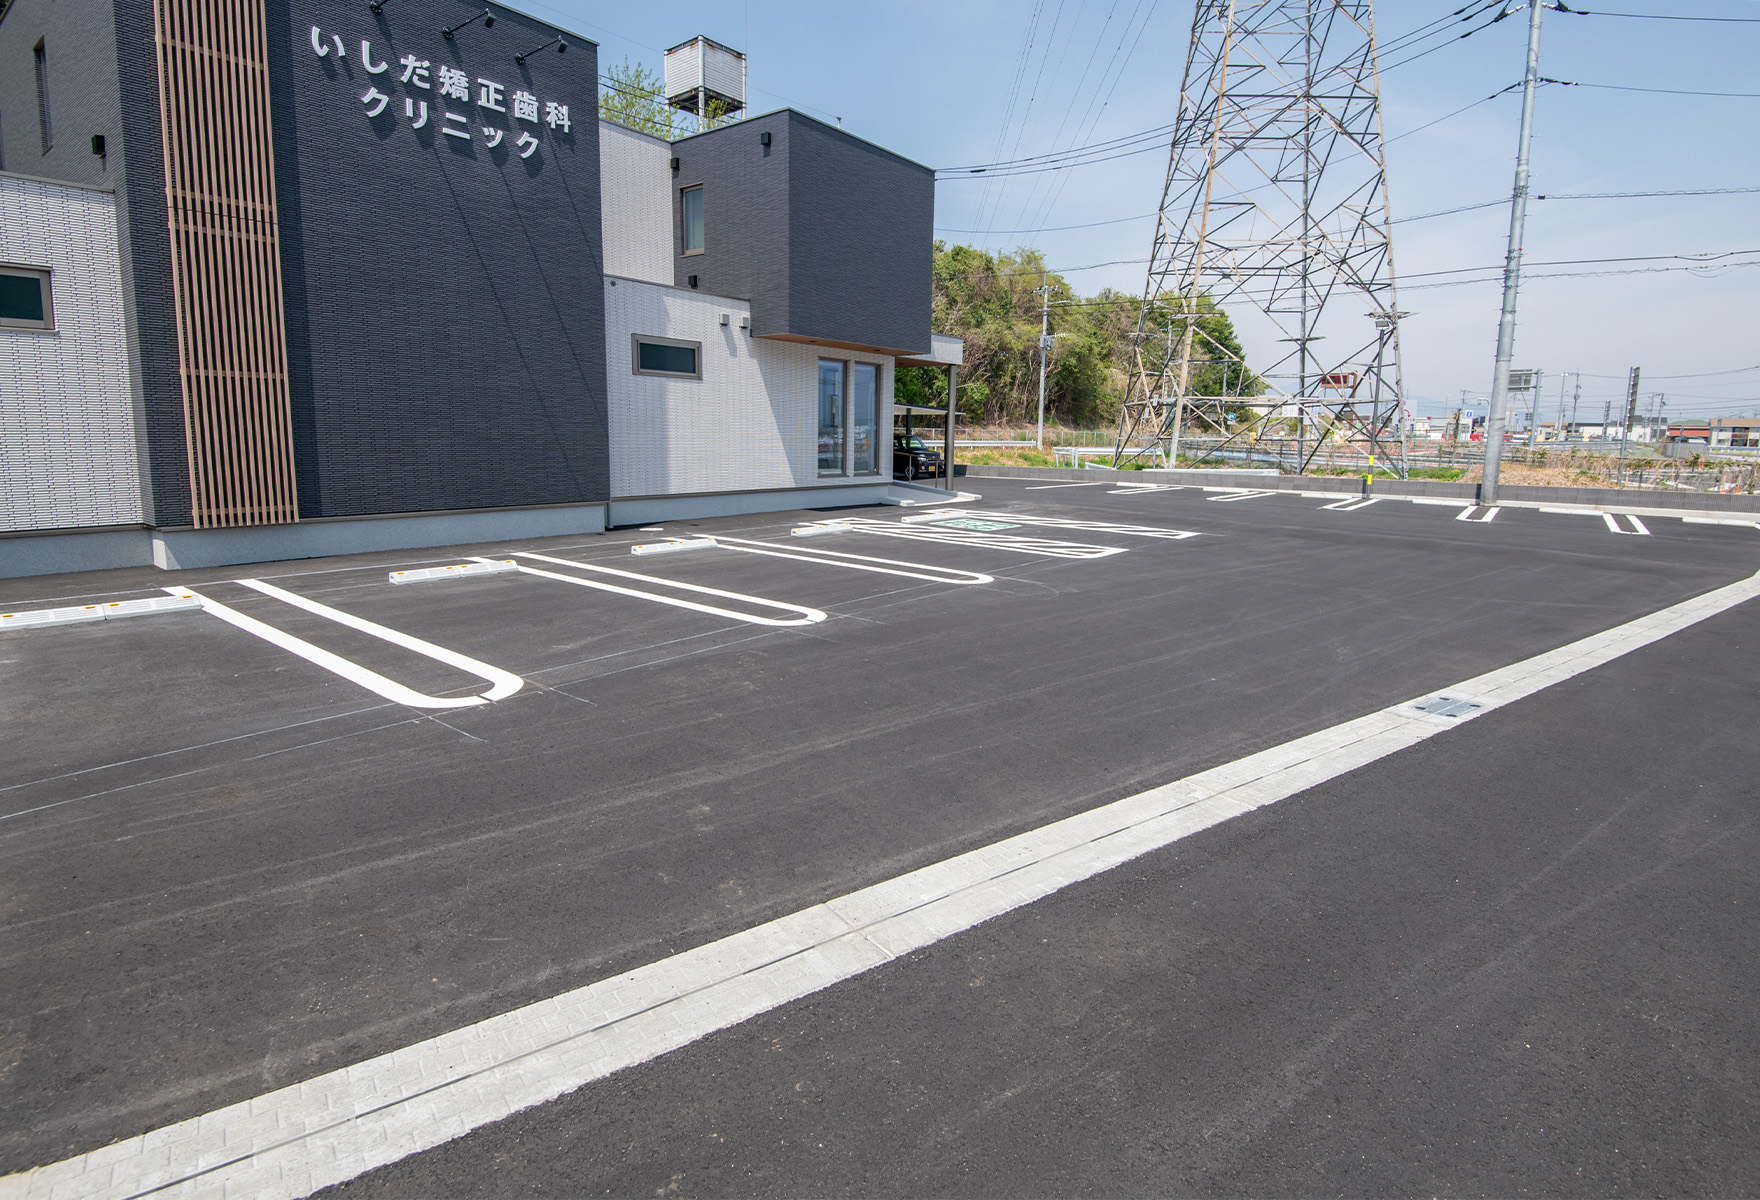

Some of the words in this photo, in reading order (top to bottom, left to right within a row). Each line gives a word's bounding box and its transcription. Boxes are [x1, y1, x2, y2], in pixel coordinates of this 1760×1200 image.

[311, 26, 571, 133] いしだ矯正歯科
[361, 87, 539, 159] クリニック
